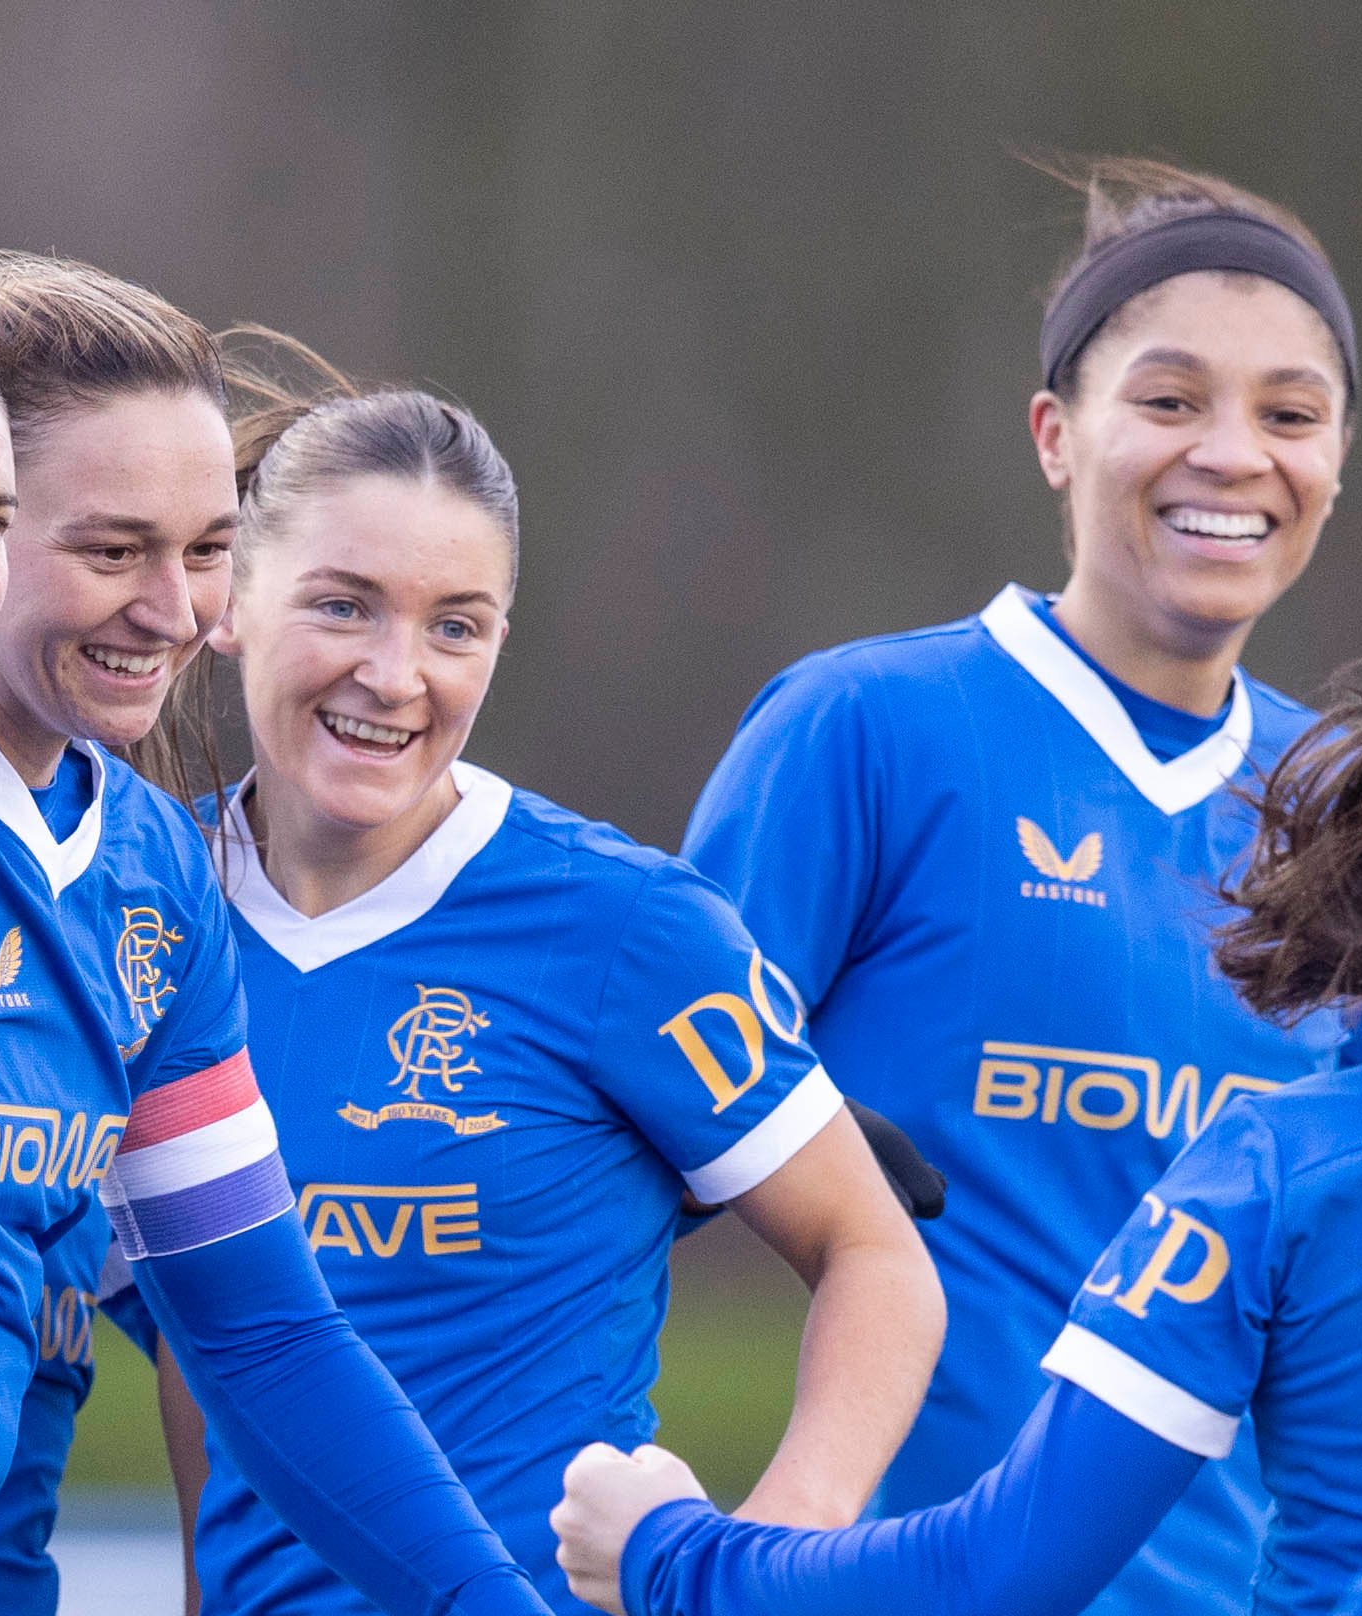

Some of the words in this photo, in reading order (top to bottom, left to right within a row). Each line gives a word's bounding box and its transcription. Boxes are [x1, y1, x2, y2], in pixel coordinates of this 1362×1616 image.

[1020, 880, 1108, 908] CASTORE
[973, 1041, 1291, 1142] BIOW
[298, 1183, 482, 1258] AVE
